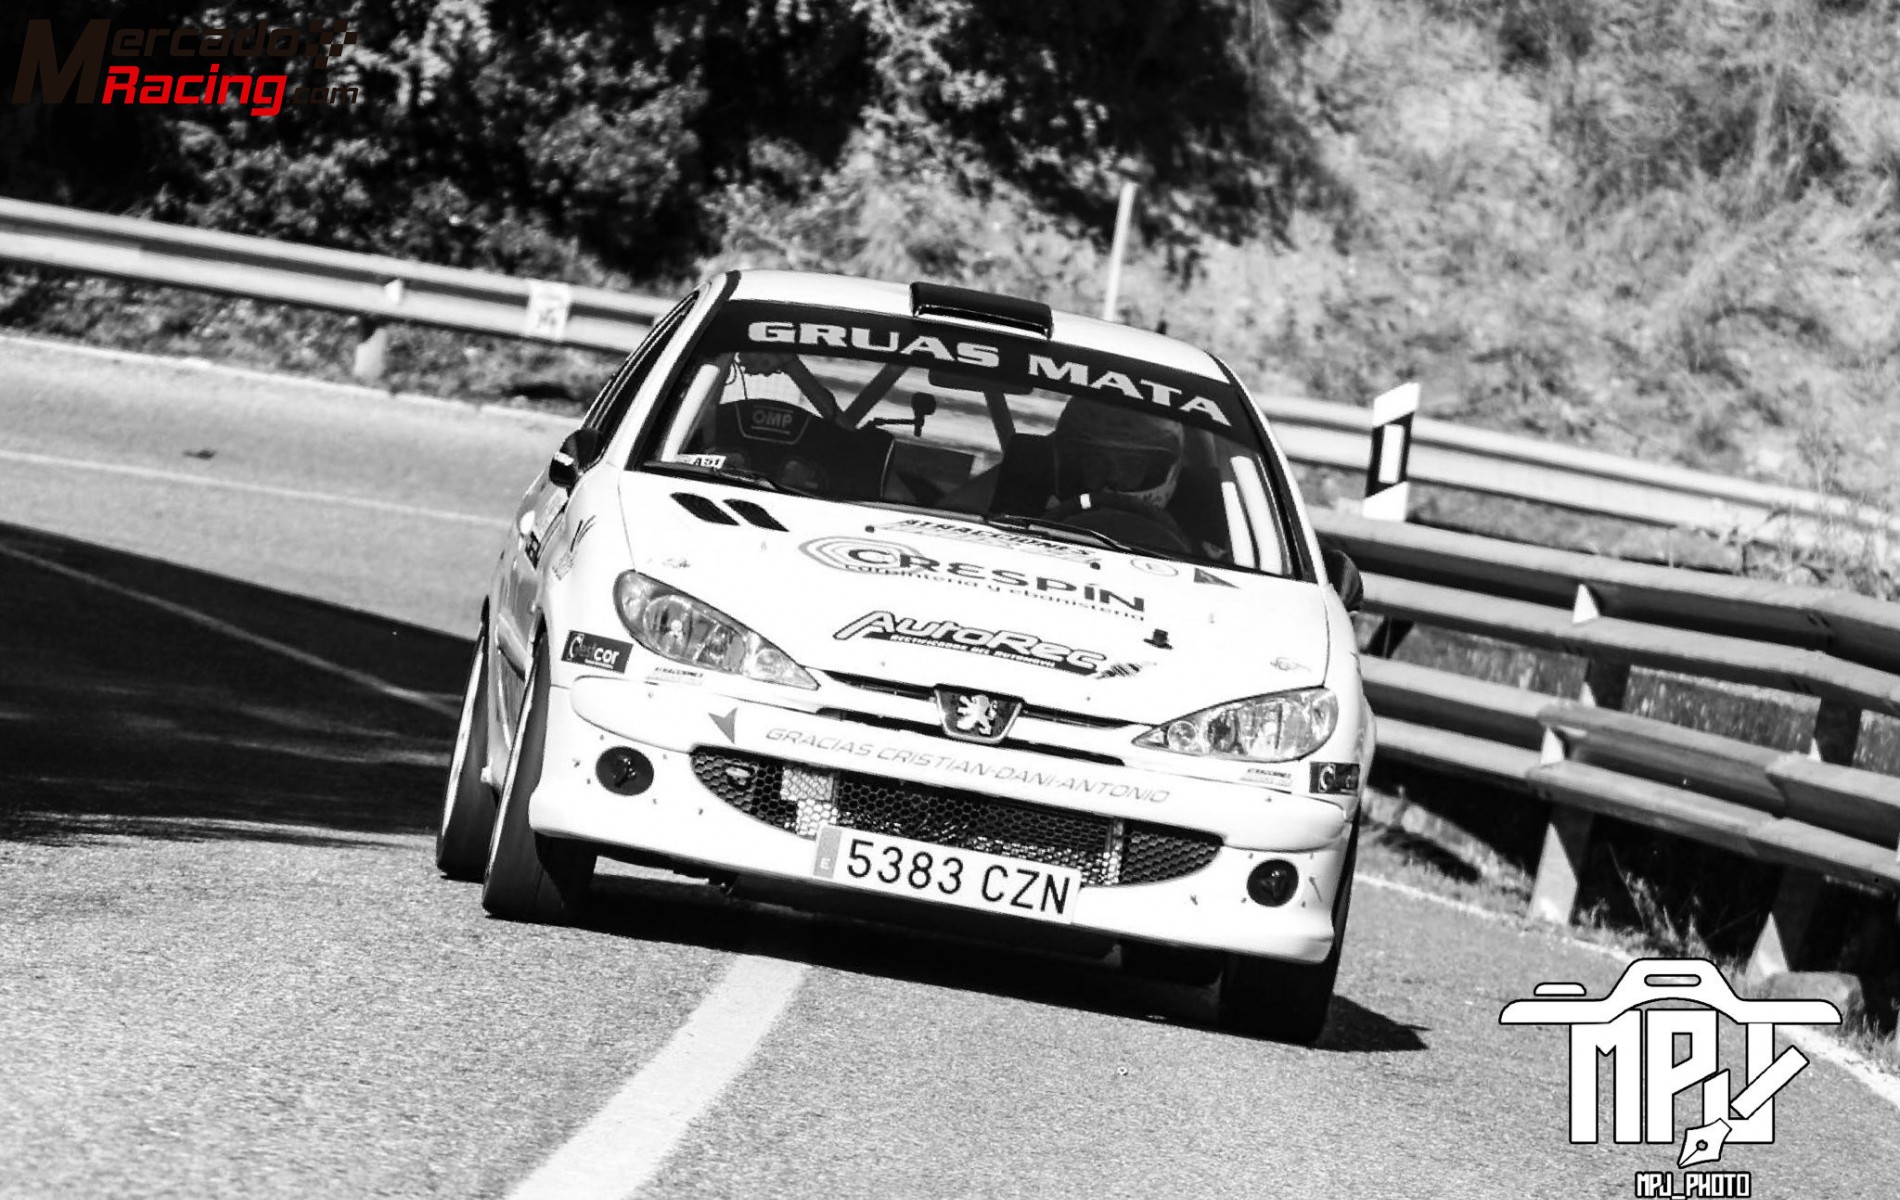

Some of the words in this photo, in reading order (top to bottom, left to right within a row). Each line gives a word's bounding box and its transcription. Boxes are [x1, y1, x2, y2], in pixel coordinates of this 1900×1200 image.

[748, 321, 1000, 368] GRUAS
[1027, 354, 1233, 428] MATA
[752, 411, 793, 427] OMP
[833, 610, 1107, 669] AutoRec
[766, 728, 873, 757] GRACIAS
[847, 839, 965, 895] 5383
[981, 865, 1071, 914] CZN
